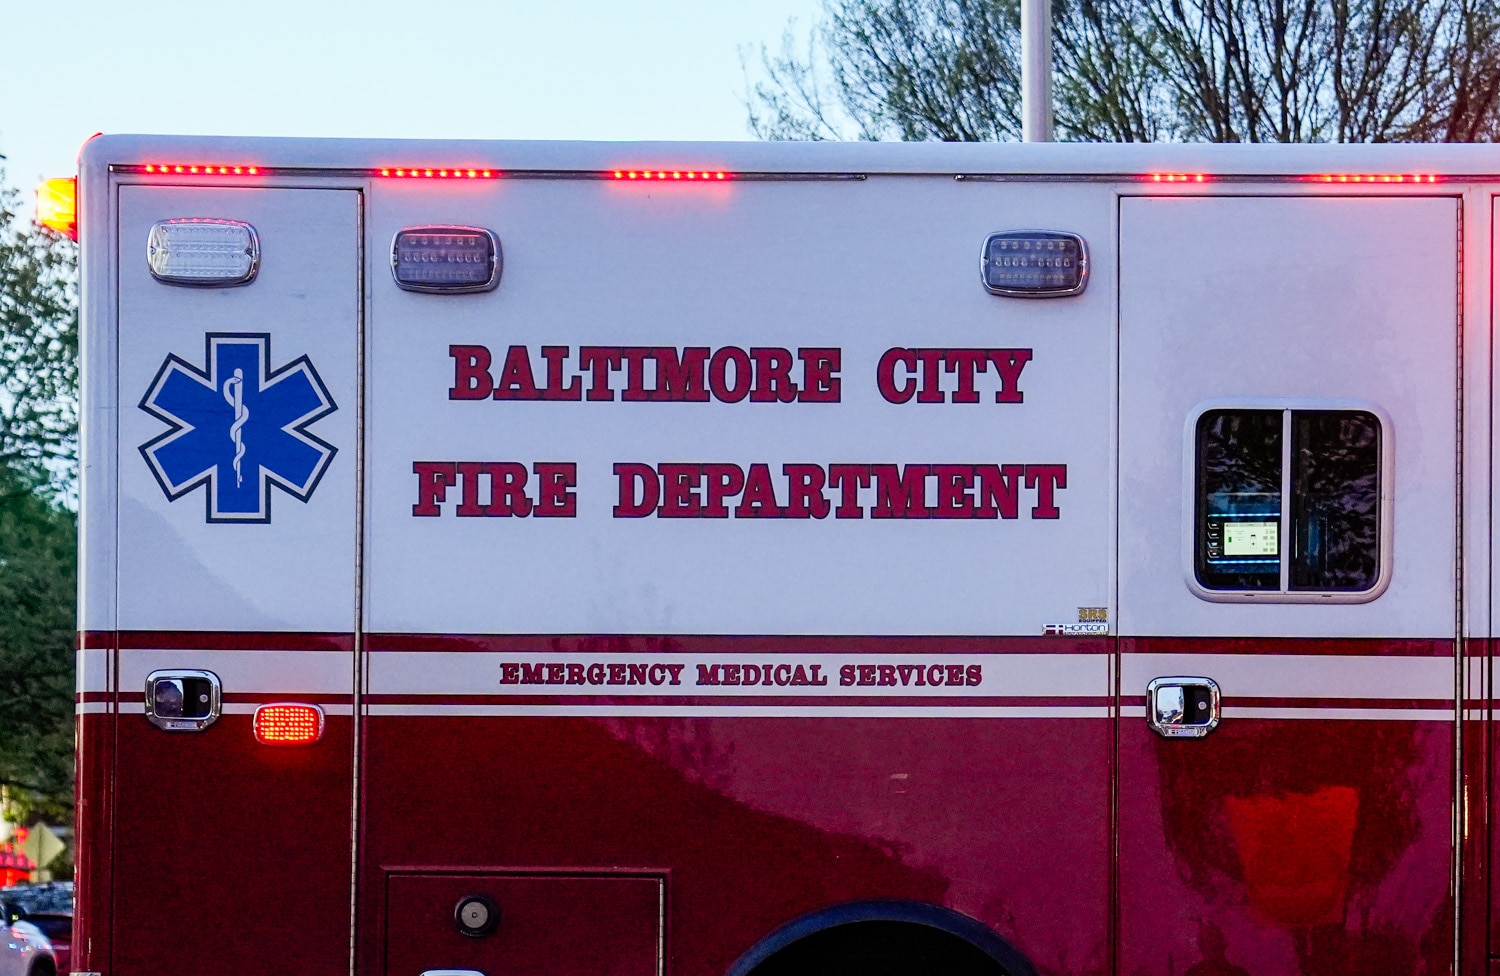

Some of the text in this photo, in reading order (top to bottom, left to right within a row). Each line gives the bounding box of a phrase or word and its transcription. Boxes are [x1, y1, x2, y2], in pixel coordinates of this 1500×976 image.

[448, 344, 1033, 404] BALTIMORE CITY
[411, 460, 1068, 520] FIRE DEPARTMENT
[1078, 609, 1107, 620] SRS
[1064, 624, 1106, 632] Horton
[499, 662, 983, 687] EMERGENCY MEDICAL SERVICES
